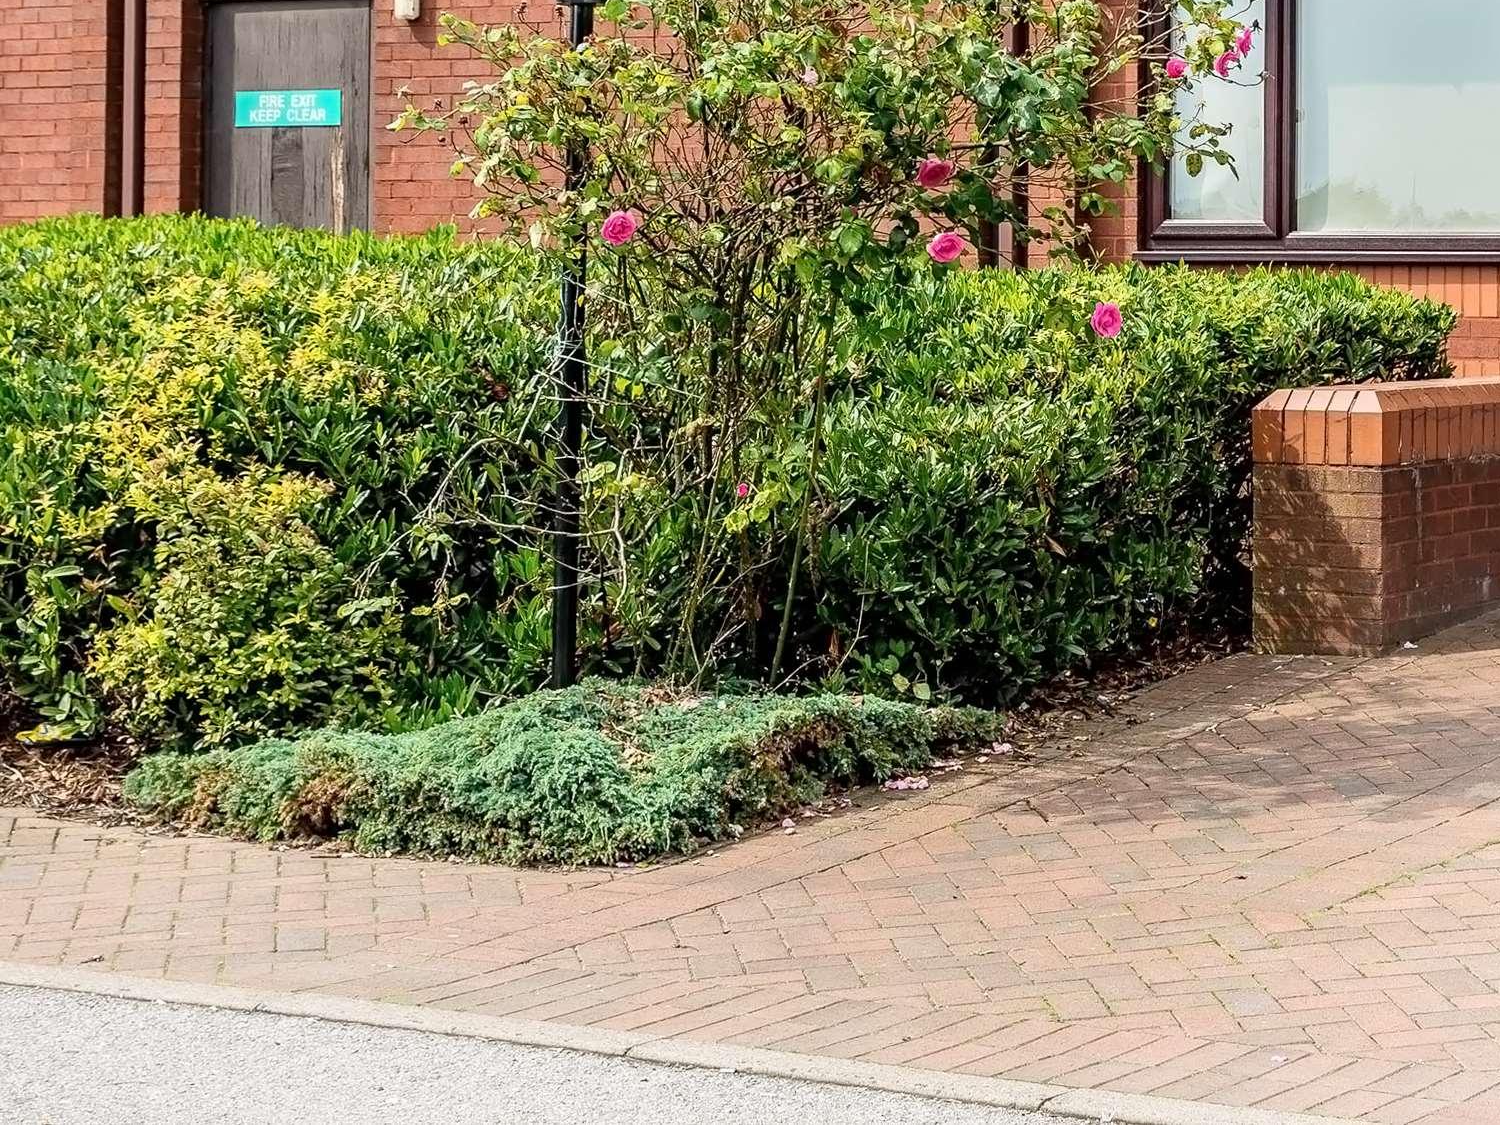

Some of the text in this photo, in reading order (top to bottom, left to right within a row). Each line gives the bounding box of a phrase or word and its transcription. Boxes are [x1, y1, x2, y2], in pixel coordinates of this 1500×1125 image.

[259, 94, 317, 108] FIRE EXIT
[249, 109, 326, 122] KEEP CLEAR
